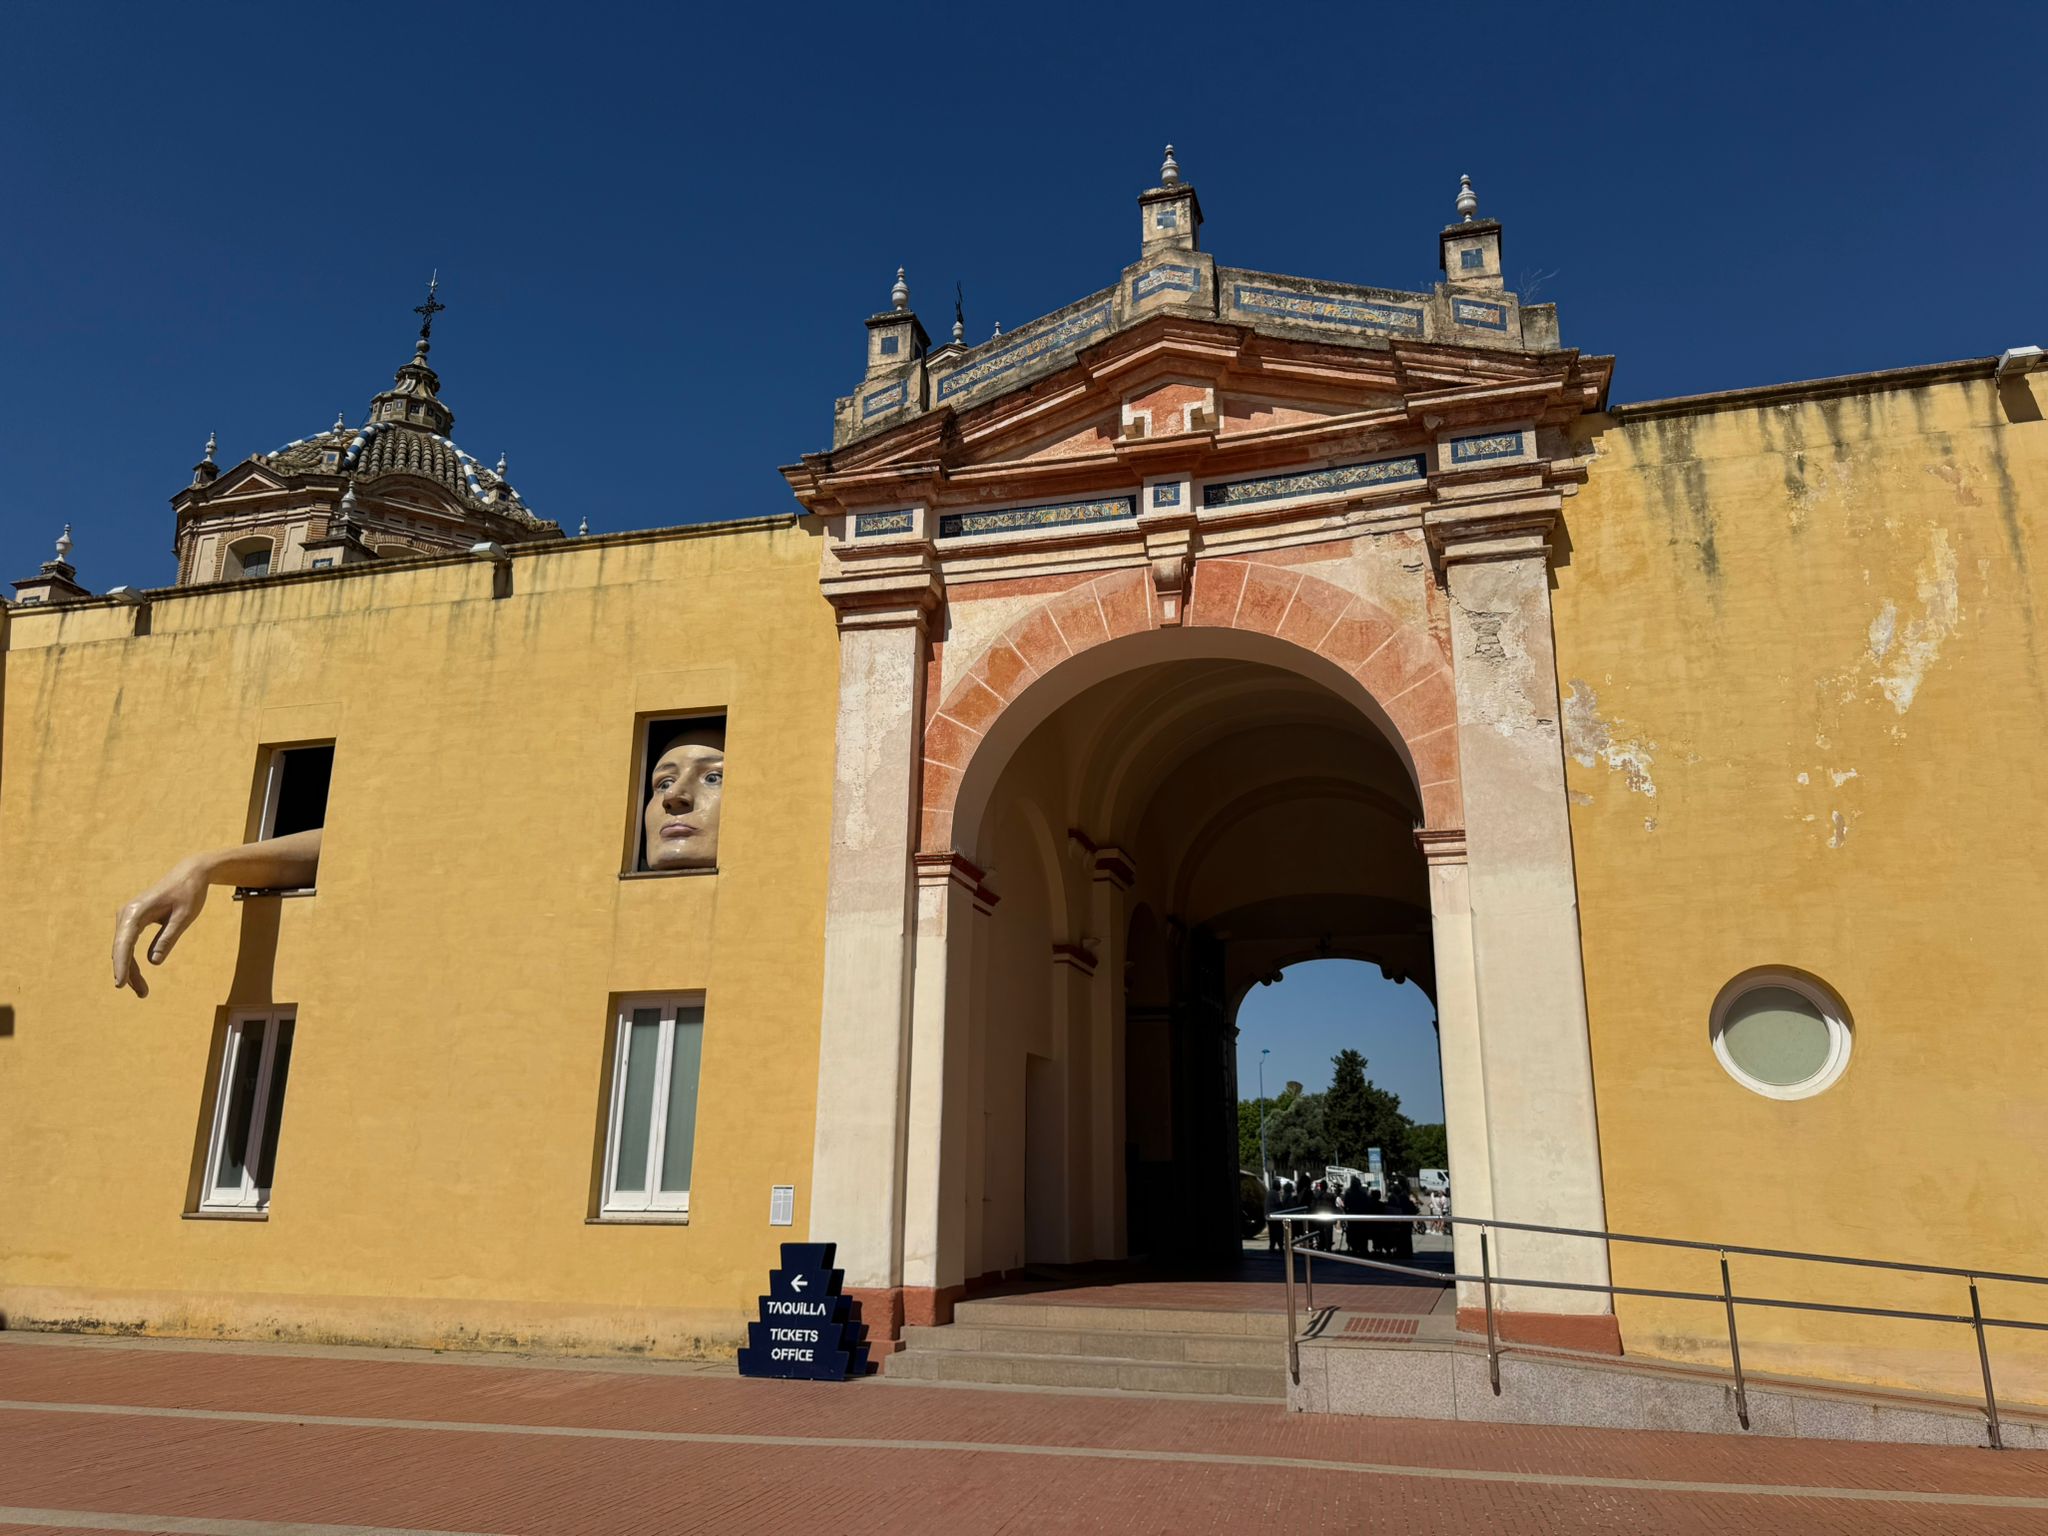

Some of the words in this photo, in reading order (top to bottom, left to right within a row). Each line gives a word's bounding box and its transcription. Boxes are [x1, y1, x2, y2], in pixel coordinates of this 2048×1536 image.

[767, 1301, 826, 1316] TAQUILLA
[770, 1328, 819, 1342] TICKETS
[771, 1348, 814, 1361] OFFICE
